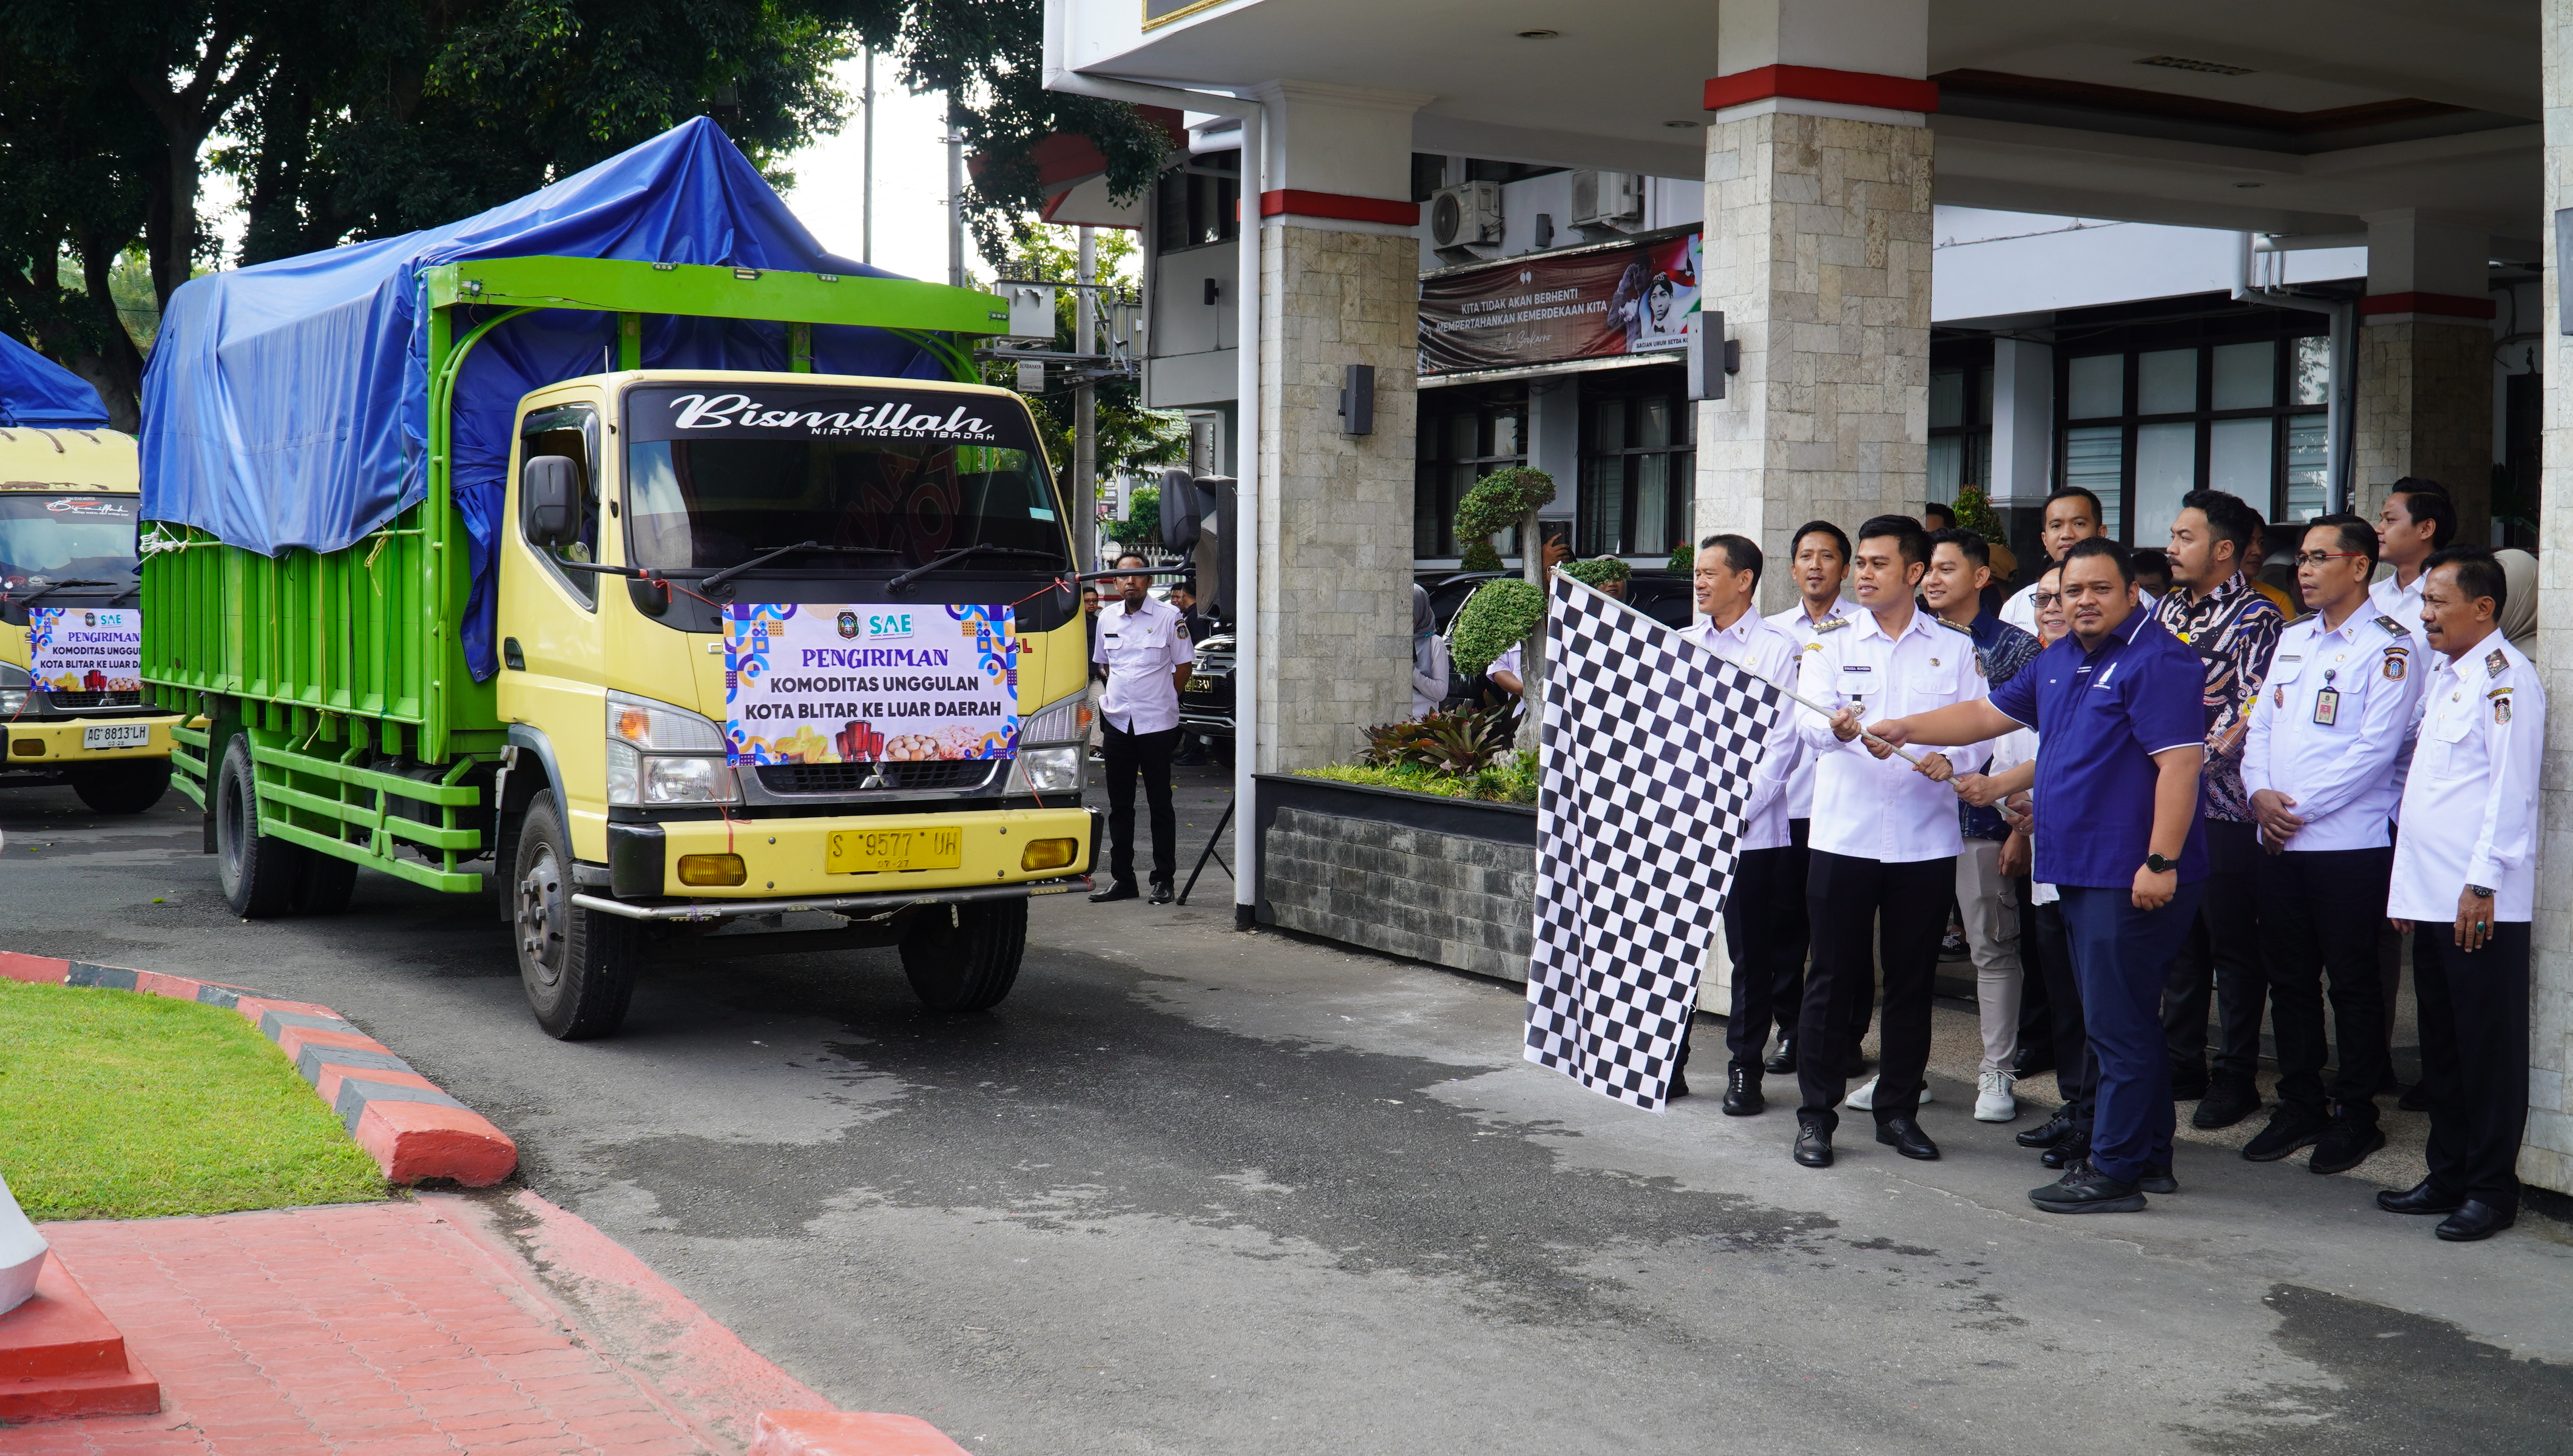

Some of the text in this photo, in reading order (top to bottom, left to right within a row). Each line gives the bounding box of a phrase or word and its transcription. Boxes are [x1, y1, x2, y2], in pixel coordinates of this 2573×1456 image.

[1461, 288, 1578, 315] KITA TIDAK AKAN BERHENTI
[1436, 300, 1608, 333] MEMPERTAHANKAN KEMERDEKAAN KITA
[669, 393, 993, 433] Bismillah
[811, 427, 996, 441] NIAT INGSUN IBADAH
[101, 614, 121, 625] SAE
[869, 614, 911, 635] SAE
[68, 632, 140, 643] PENGIRIMAN
[53, 646, 105, 655] KOMODITAS
[802, 649, 949, 669] PENGIRIMAN
[41, 660, 63, 669] KOTA
[66, 660, 95, 669] BLITAR
[96, 660, 107, 669] KE
[109, 660, 130, 669] LUAR
[770, 676, 979, 693] KOMODITAS UNGGULAN
[745, 701, 1001, 720] KOTA BLITAR KE LUAR DAERAH
[87, 726, 146, 741] AG 8813 LH
[832, 831, 958, 858] S 9577 UH
